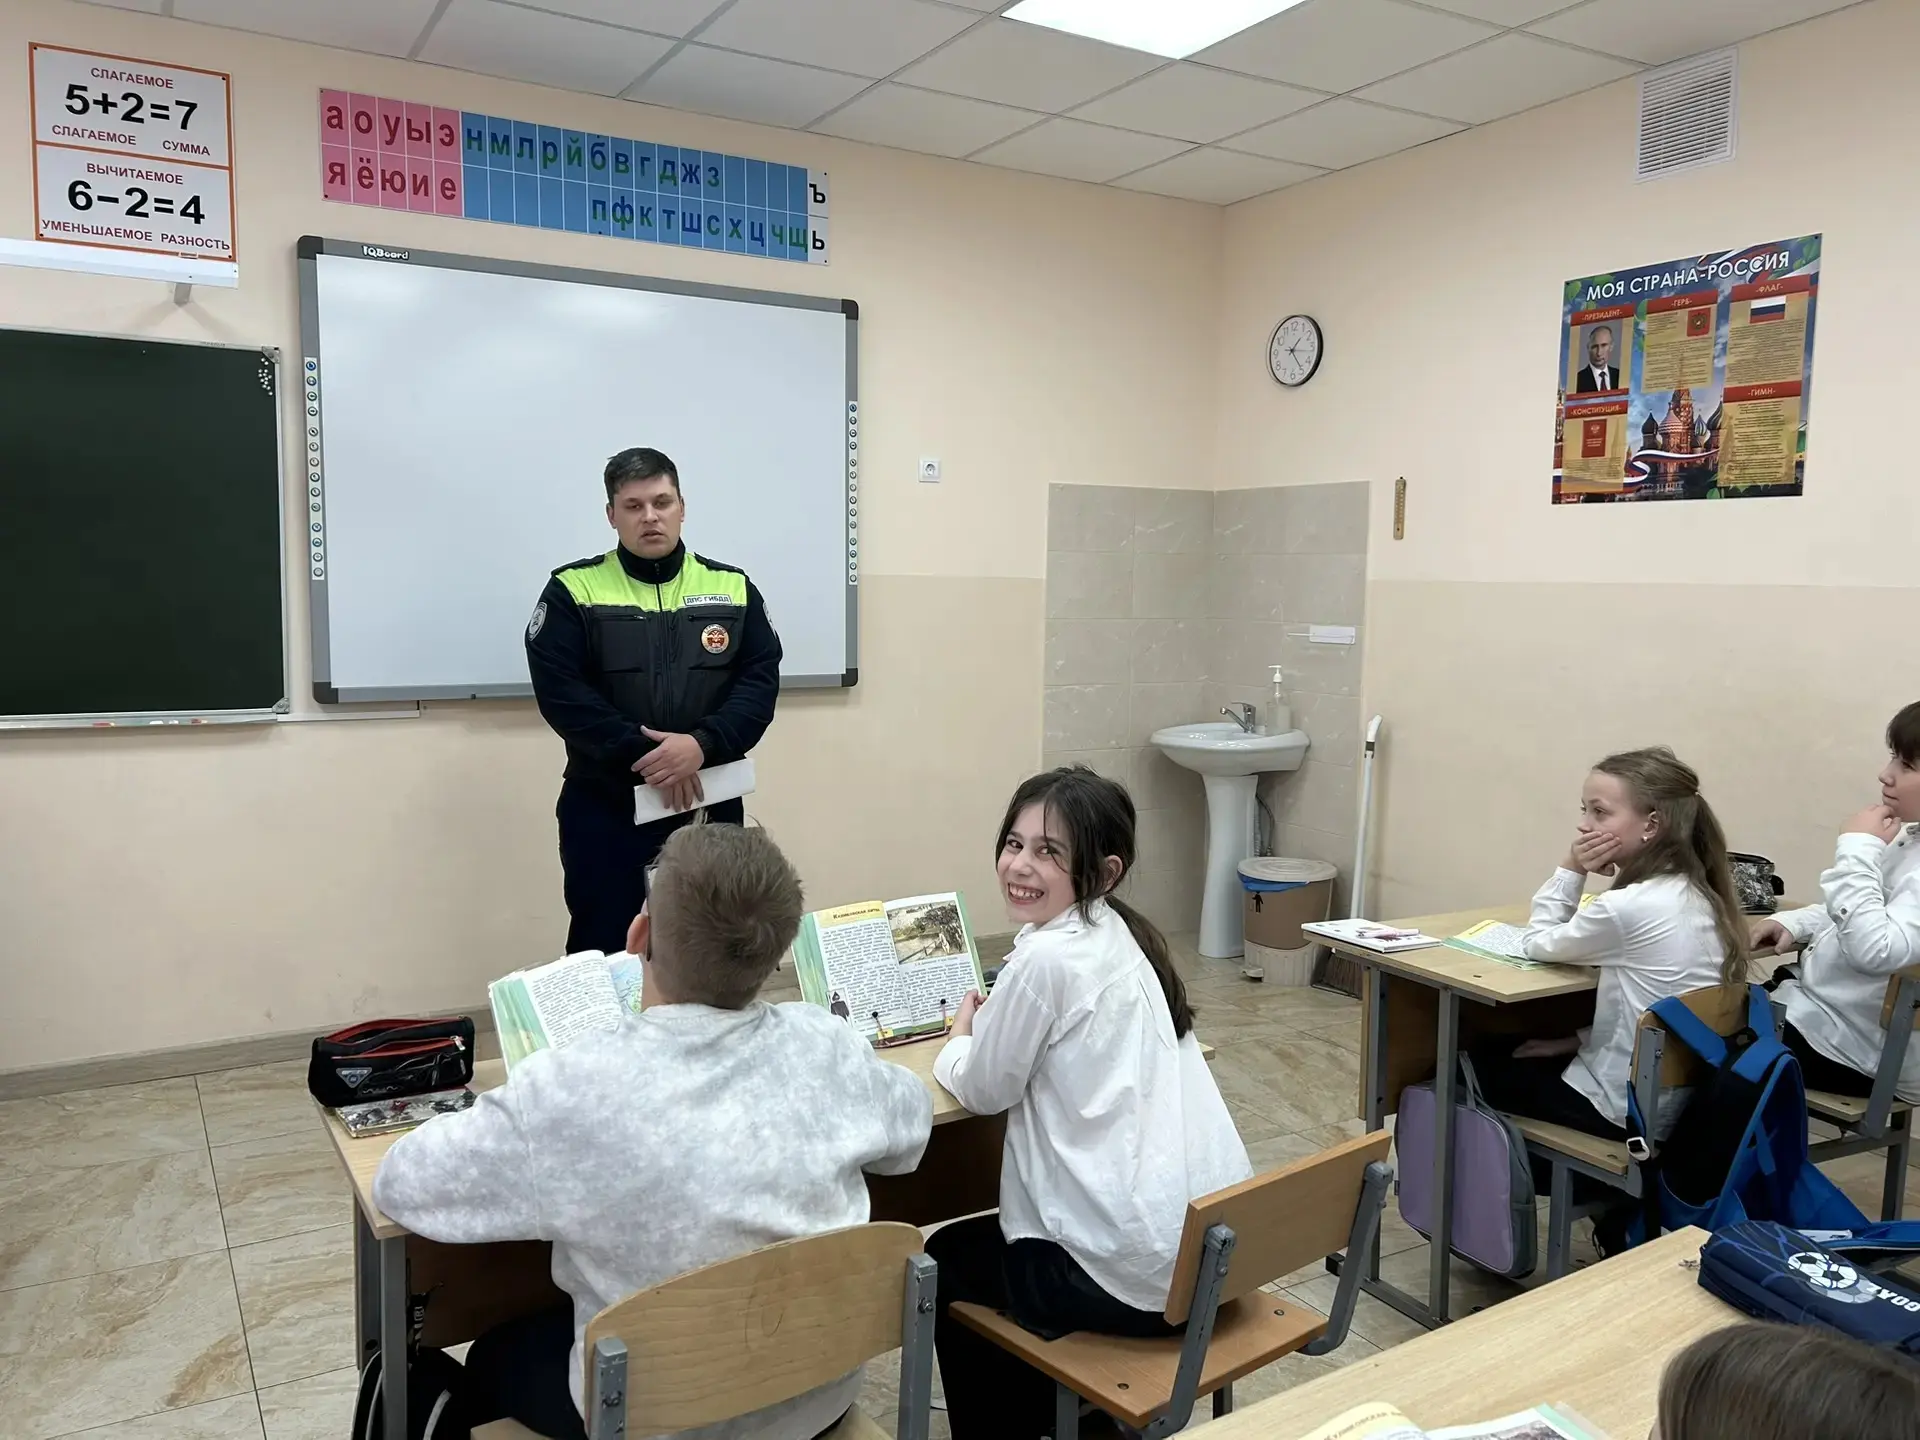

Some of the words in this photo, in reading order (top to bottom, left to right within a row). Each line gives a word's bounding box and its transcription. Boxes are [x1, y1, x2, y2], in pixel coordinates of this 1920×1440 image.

[90, 67, 174, 90] СЛАГАЕМОЕ
[64, 83, 198, 130] 5+2=7
[51, 124, 137, 146] СЛАГАЕМОЕ
[162, 139, 211, 156] СУММА
[86, 162, 183, 185] ВЫЧИТАЕМОЕ
[42, 219, 153, 242] УМЕНЬШАЕМОЕ
[160, 233, 230, 251] РАЗНОСТЬ
[361, 245, 410, 261] IQBoard
[1586, 279, 1625, 302] МОЯ
[1629, 250, 1790, 294] СТРАНА-РОССИЯ
[686, 596, 703, 604] ДПС
[703, 595, 730, 604] ГИБДД
